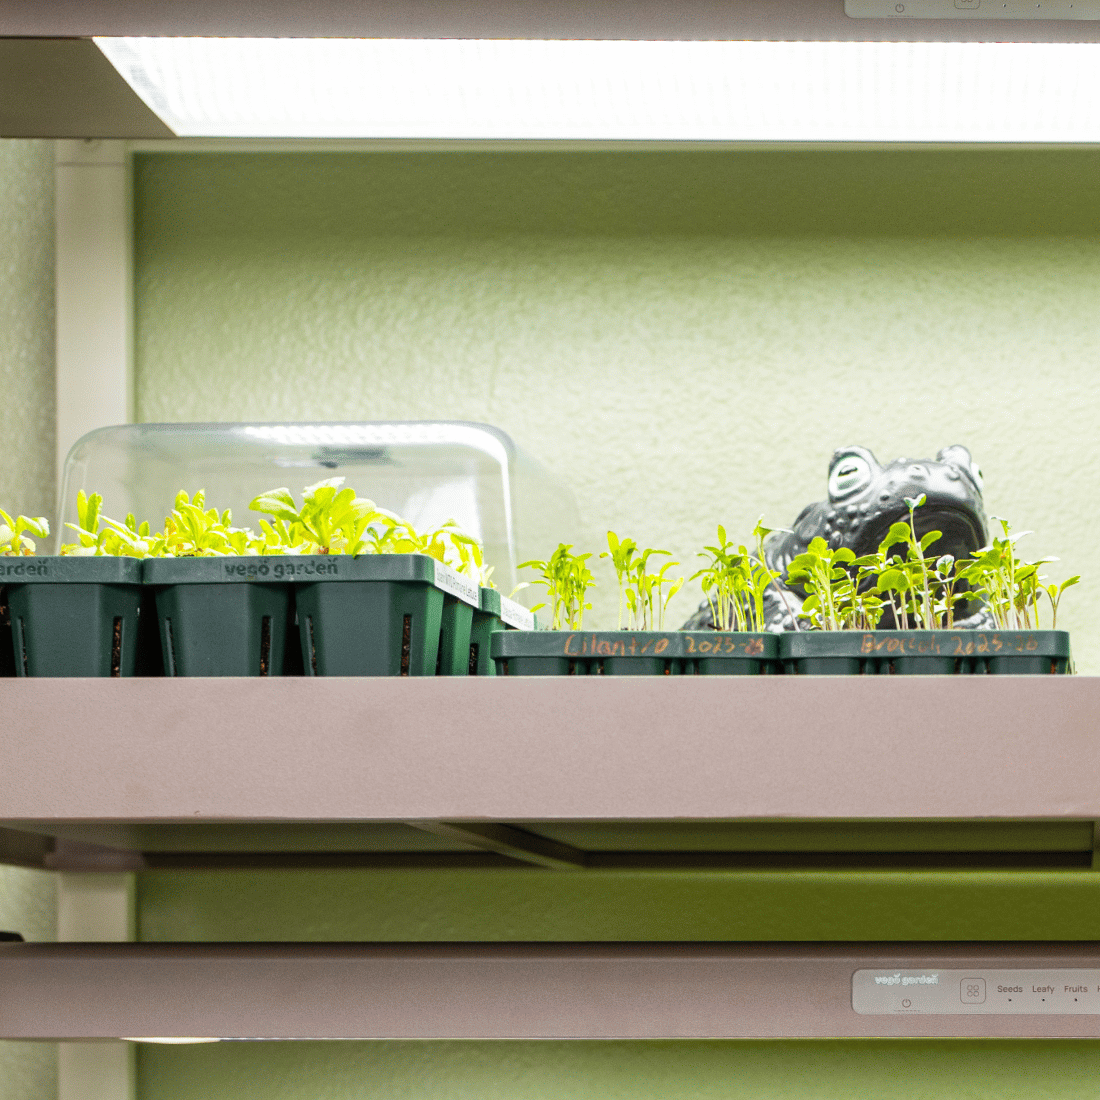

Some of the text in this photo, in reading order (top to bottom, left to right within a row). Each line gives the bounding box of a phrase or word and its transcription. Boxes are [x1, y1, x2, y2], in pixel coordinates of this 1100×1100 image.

[563, 634, 669, 657] Cilantro
[997, 985, 1023, 993] Seeds
[1032, 985, 1055, 995] Leafy
[1064, 985, 1088, 993] Fruits
